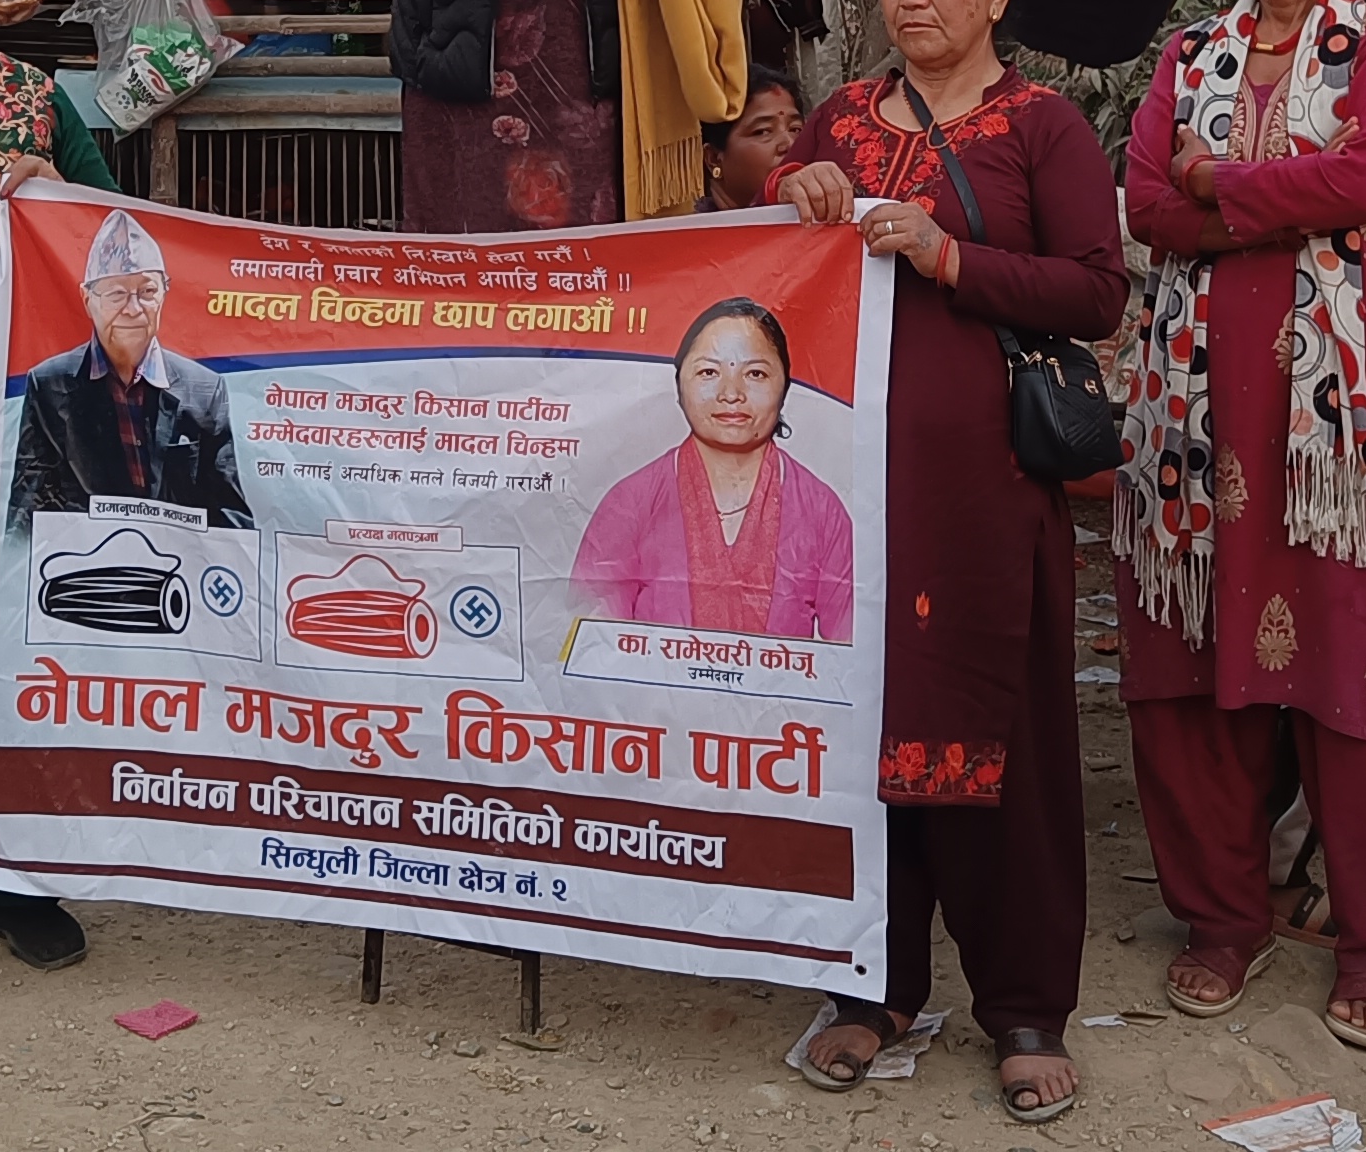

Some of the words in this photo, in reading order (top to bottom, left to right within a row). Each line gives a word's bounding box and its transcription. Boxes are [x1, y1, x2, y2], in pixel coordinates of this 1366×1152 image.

[260, 233, 290, 251] देश
[298, 240, 315, 254] र
[486, 251, 525, 264] सेवा
[230, 257, 324, 281] समाजवादी
[333, 264, 383, 286] प्रचार
[393, 264, 467, 288] अभियान
[477, 266, 538, 291] अगाडि
[207, 290, 302, 320] मादल
[310, 286, 425, 327] चिन्हमा
[432, 301, 498, 329] छाप
[627, 307, 647, 334] !!
[265, 383, 329, 411] नेपाल
[336, 391, 407, 419] मजदुर
[414, 390, 490, 419] किसान
[497, 397, 572, 423] पार्टीका
[434, 432, 500, 455] मादल
[506, 430, 580, 459] चिन्हमा
[257, 461, 285, 477] छाप
[293, 461, 333, 482] लगाई
[341, 463, 403, 484] अत्यधिक
[410, 468, 444, 486] मतले
[452, 467, 499, 490] विजयी
[348, 528, 384, 541] प्रत्यक्ष
[387, 530, 439, 543] मतपत्रमा
[617, 633, 651, 656] का.
[660, 634, 753, 667] रामेश्वरी
[759, 643, 818, 680] कोजू
[687, 665, 745, 686] उम्मेदवार
[15, 656, 204, 734] नेपाल
[223, 685, 423, 770] मजदुर
[445, 689, 667, 782] किसान
[688, 723, 828, 799] पार्टी
[111, 762, 239, 813] निर्वाचन
[249, 779, 403, 830] परिचालन
[411, 799, 565, 849] समितिको
[573, 818, 727, 870] कार्यालय
[260, 836, 361, 879] सिन्धुली
[368, 848, 451, 887] जिल्ला
[458, 860, 507, 894] क्षेत्र
[515, 870, 543, 898] नं.
[551, 879, 568, 902] २
